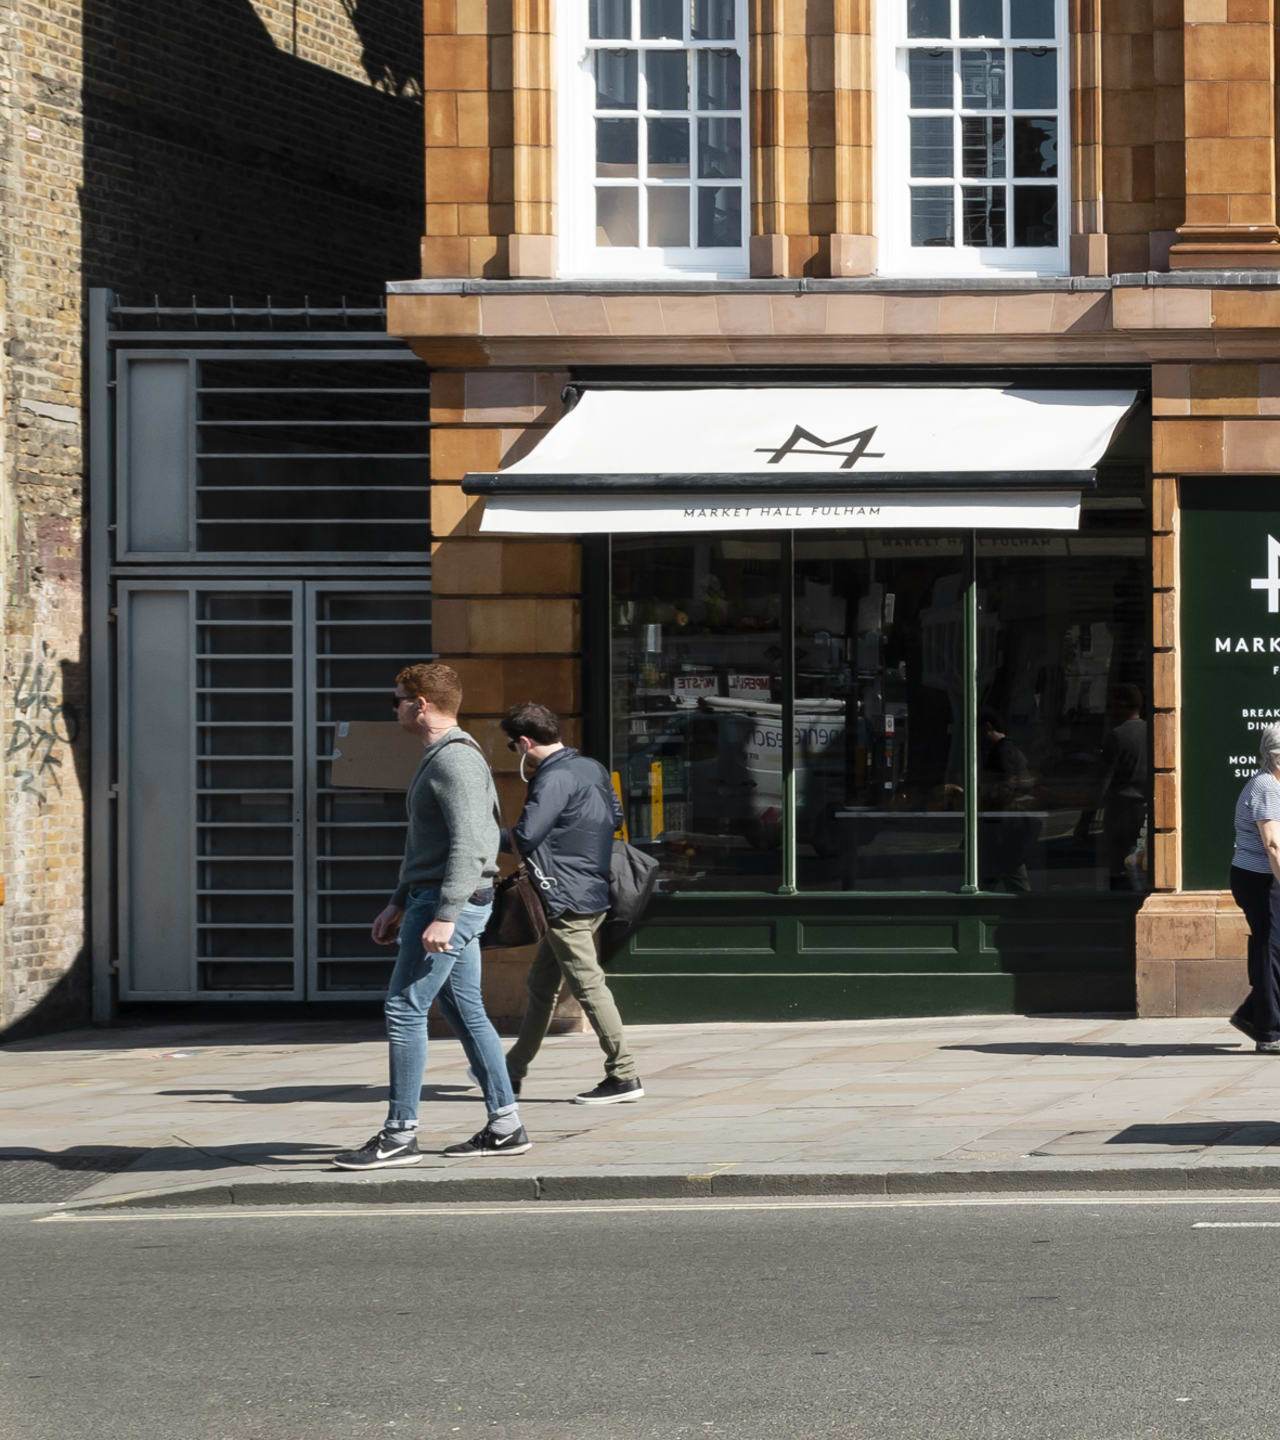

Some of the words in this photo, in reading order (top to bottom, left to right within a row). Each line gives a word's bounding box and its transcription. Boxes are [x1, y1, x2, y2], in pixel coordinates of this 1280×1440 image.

[683, 506, 753, 518] MARKET
[760, 506, 803, 517] HALL
[811, 505, 881, 516] FULHAM
[1229, 755, 1257, 765] MON
[1234, 768, 1259, 778] SUN
